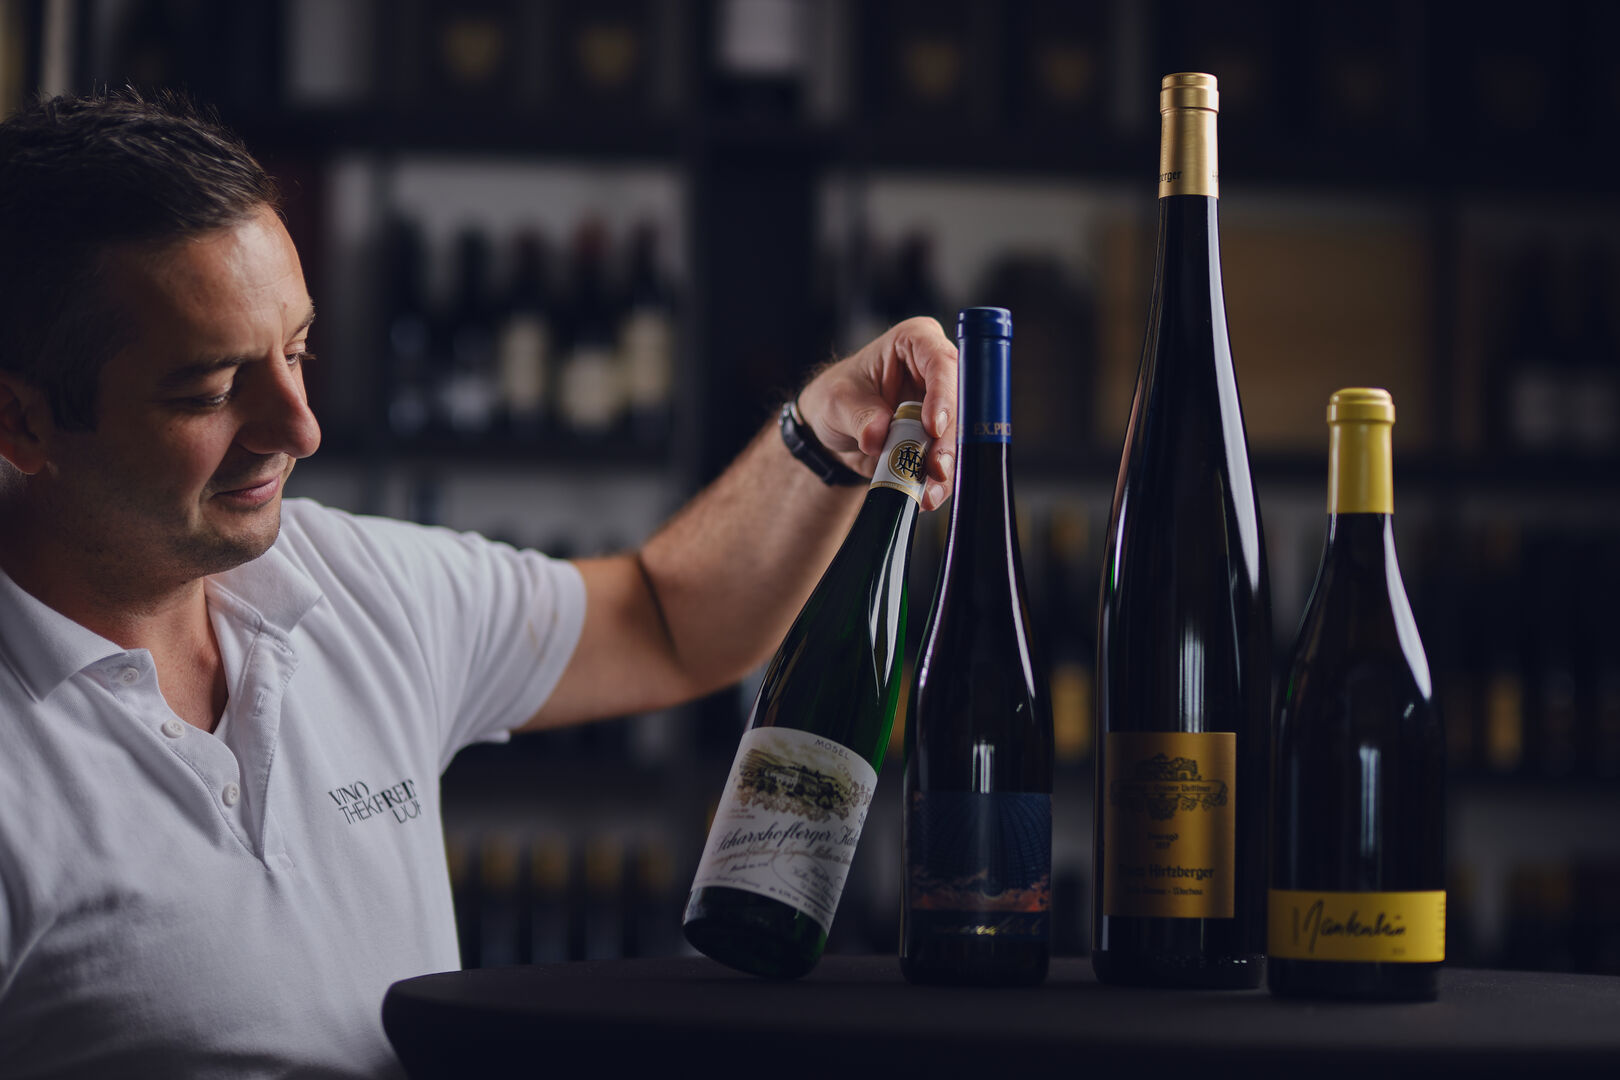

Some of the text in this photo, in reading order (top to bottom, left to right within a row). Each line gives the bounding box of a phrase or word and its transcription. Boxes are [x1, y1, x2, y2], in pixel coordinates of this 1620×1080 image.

[1159, 170, 1182, 183] erger
[814, 738, 850, 761] MOSEL
[328, 780, 371, 806] VINO
[1149, 864, 1216, 880] Hirtzberger
